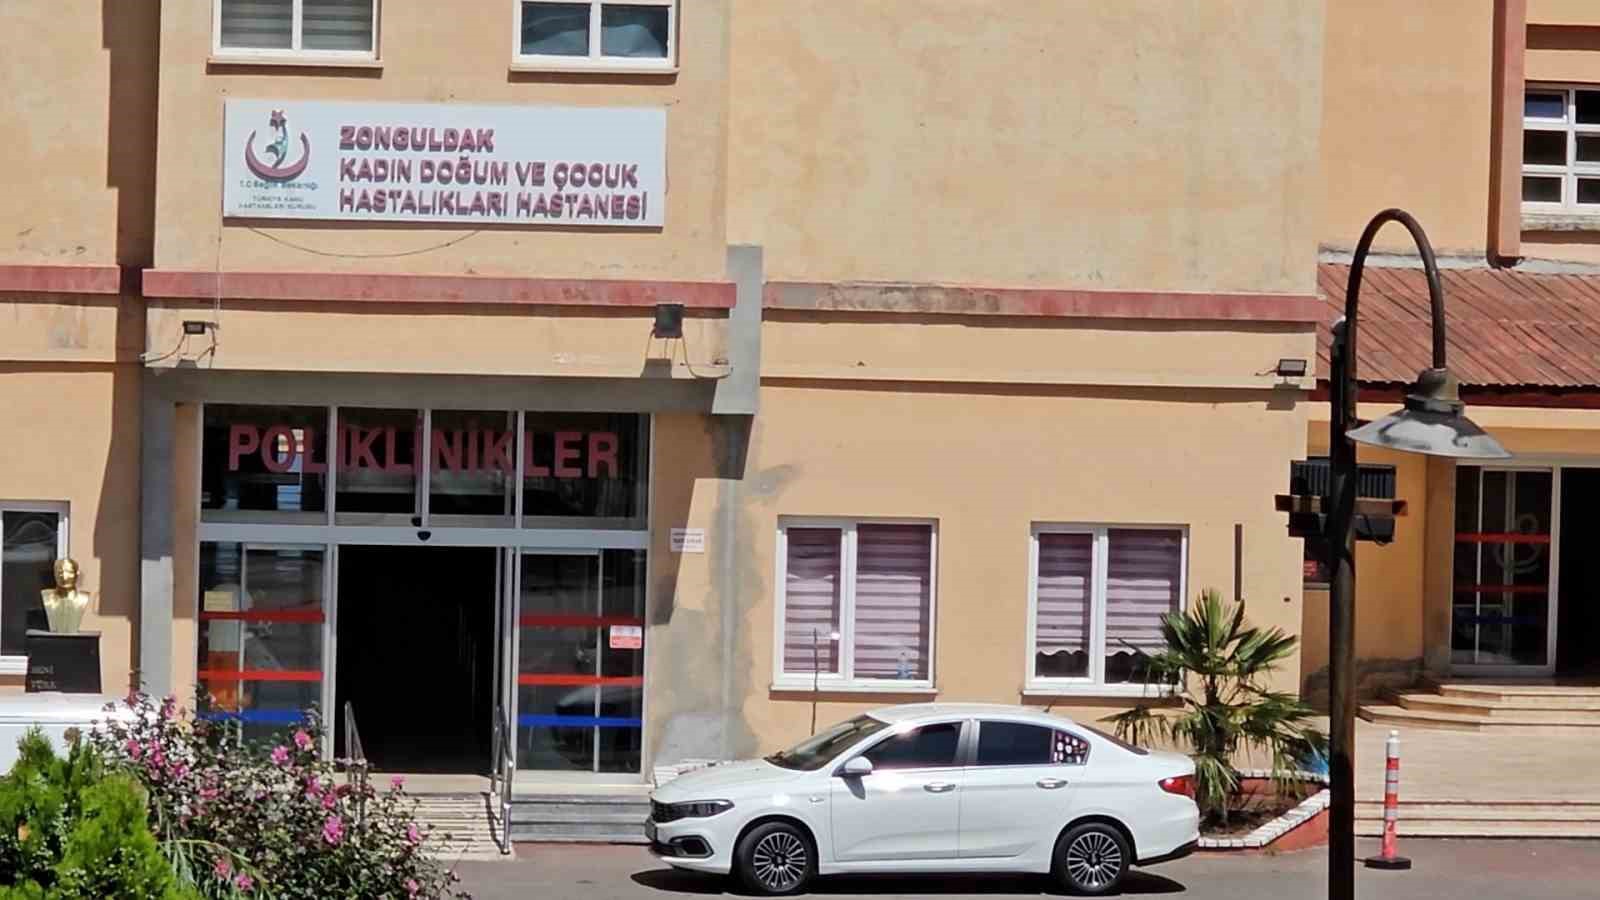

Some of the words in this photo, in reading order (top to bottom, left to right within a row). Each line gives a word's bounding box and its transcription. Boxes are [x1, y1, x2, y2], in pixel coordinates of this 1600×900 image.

[339, 126, 495, 153] ZONGULDAK
[340, 157, 412, 183] KADIN
[420, 155, 508, 186] DOĞUM
[515, 162, 546, 187] VE
[553, 162, 638, 192] ÇOCUK
[340, 188, 508, 216] HASTALIKLARI
[516, 191, 647, 220] HASTANESİ
